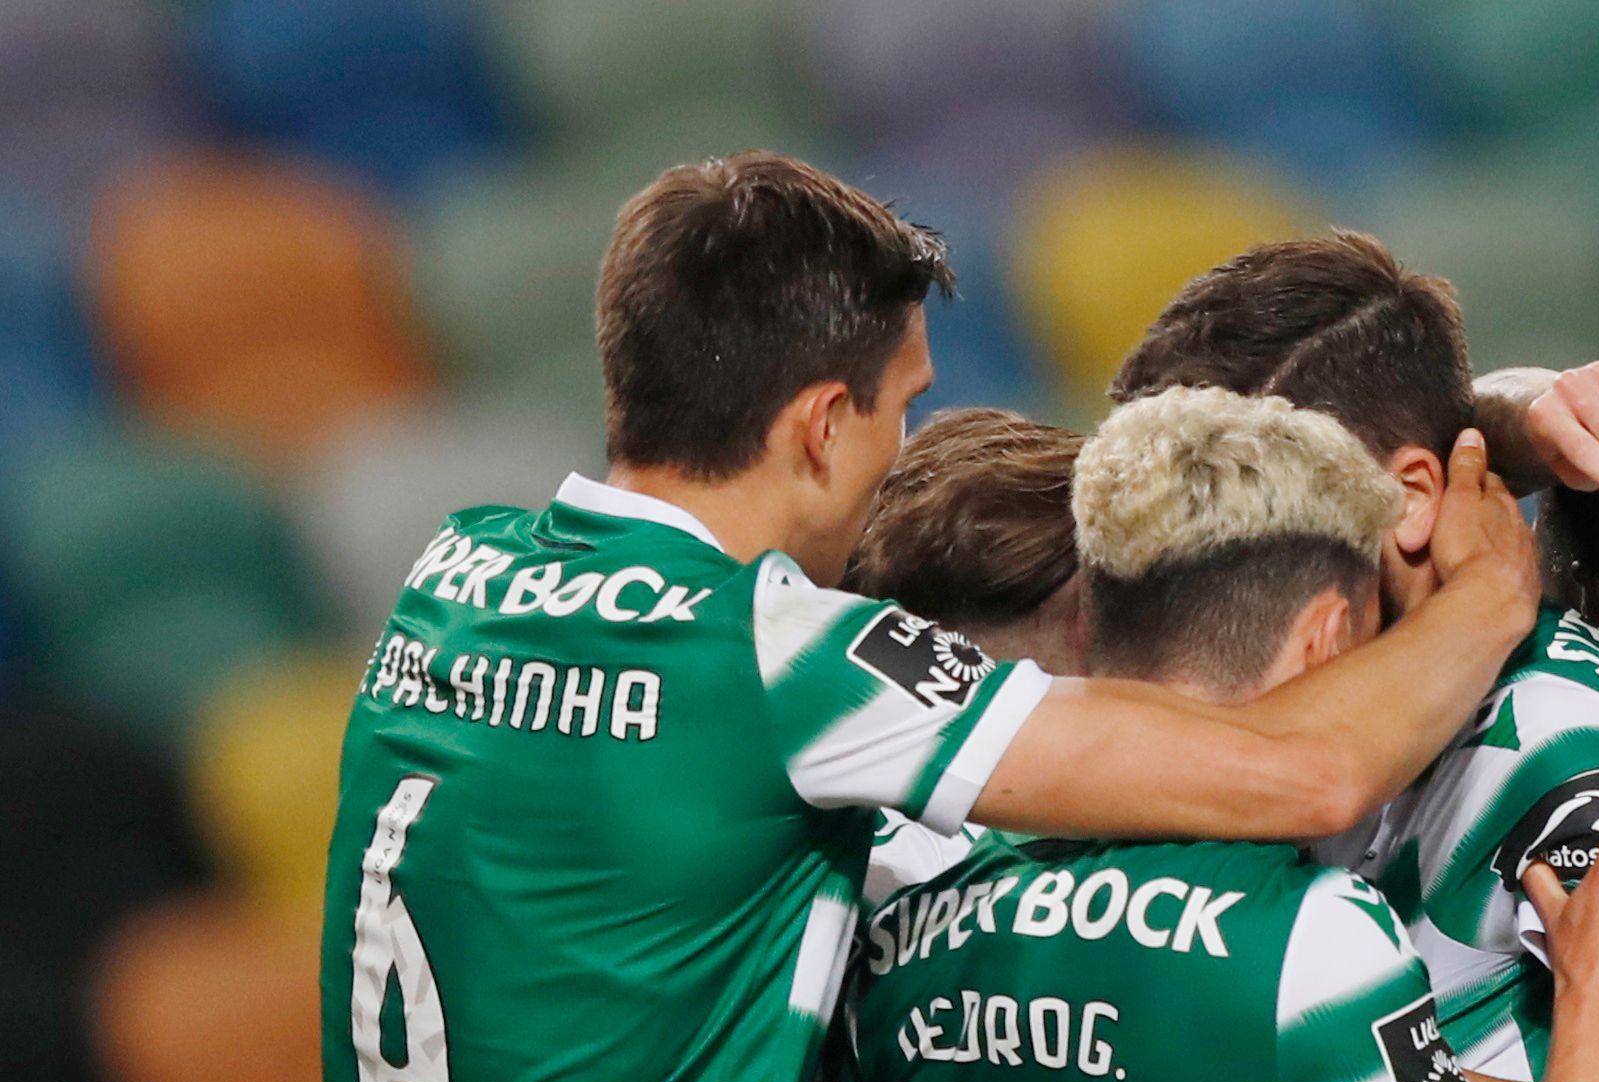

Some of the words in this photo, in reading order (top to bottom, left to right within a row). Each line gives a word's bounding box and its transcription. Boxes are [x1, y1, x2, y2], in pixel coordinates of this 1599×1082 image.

[498, 561, 712, 623] BOCK
[868, 875, 1019, 976] SUPER
[1012, 867, 1247, 958] BOCK
